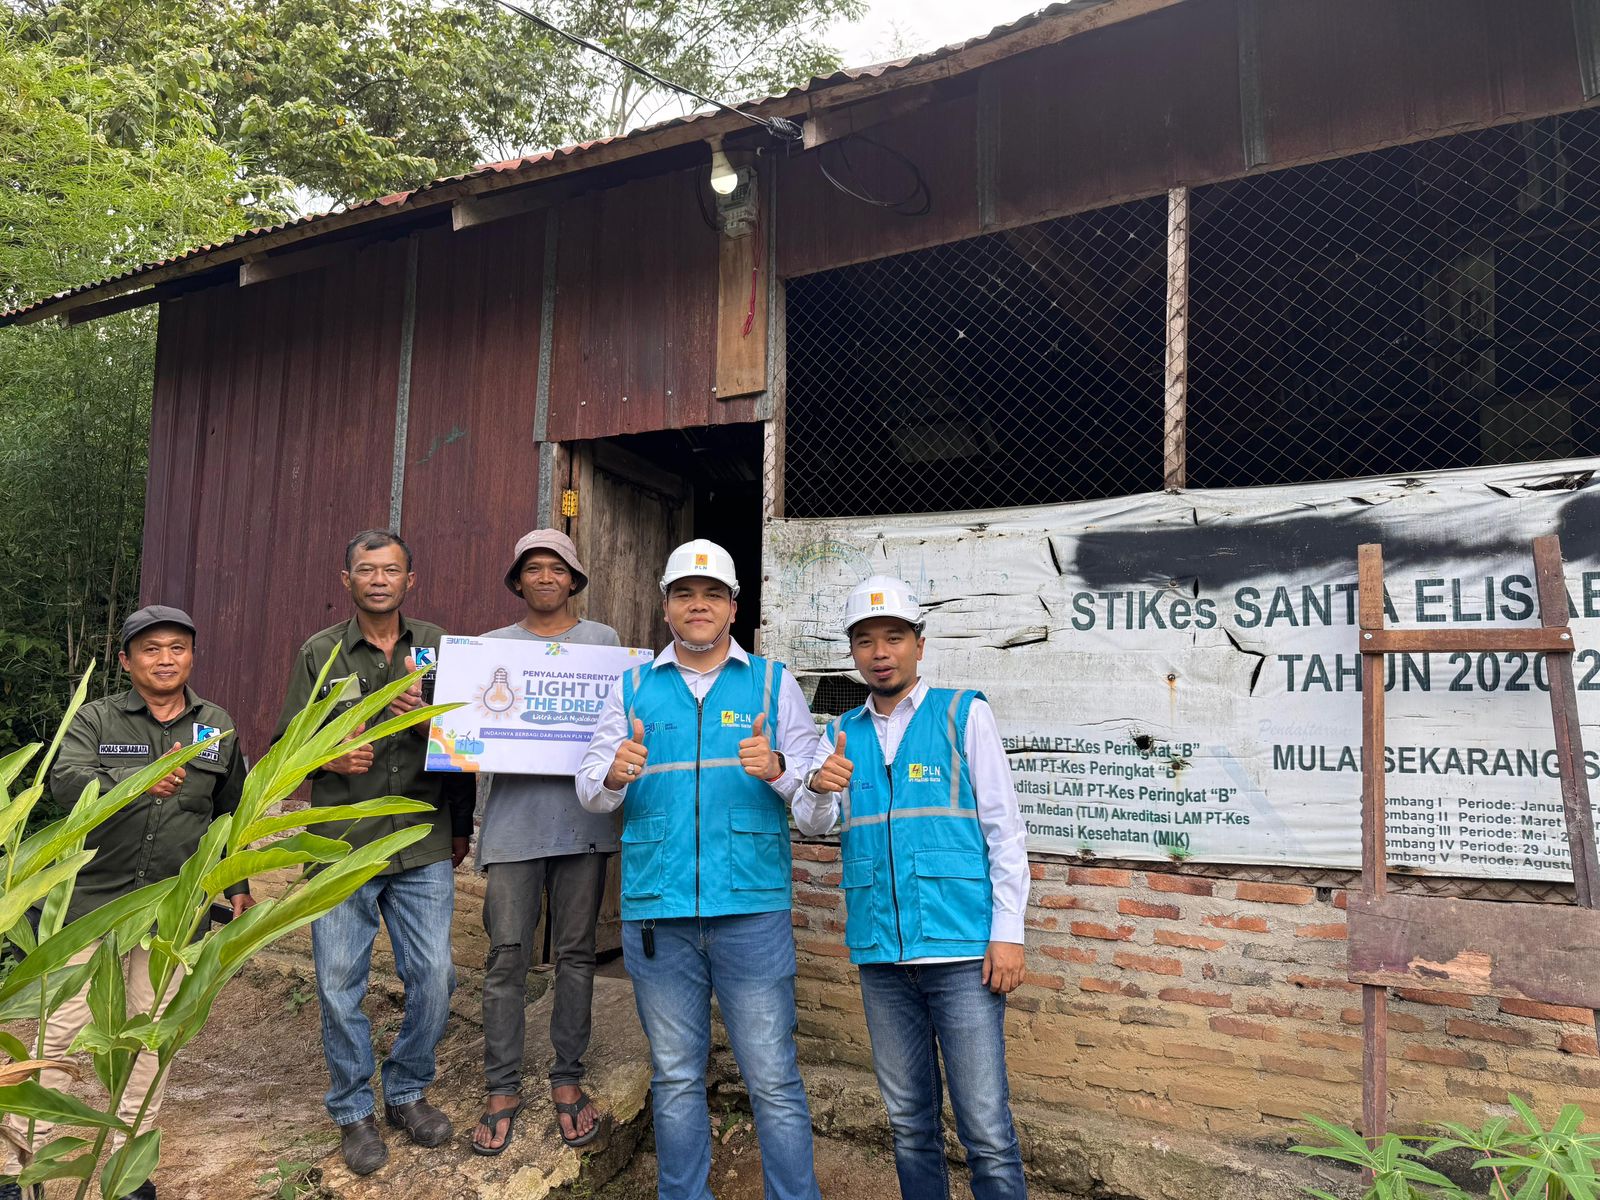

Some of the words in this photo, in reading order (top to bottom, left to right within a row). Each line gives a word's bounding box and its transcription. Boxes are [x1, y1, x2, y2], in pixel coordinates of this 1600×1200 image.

[1071, 590, 1217, 631] STIKes
[523, 670, 575, 680] PENYALAAN
[525, 680, 590, 699] LIGHT
[595, 683, 614, 699] U
[524, 697, 557, 711] THE
[561, 699, 604, 713] DREA
[734, 713, 751, 723] PLN
[1023, 736, 1051, 750] LAM
[1054, 738, 1100, 754] PT-Kes
[922, 765, 940, 775] PLN
[1009, 758, 1037, 772] LAM
[1040, 759, 1085, 774] PT-Kes
[1090, 761, 1155, 780] Peringkat
[1384, 747, 1561, 778] SEKARANG
[1054, 782, 1083, 796] LAM
[1087, 783, 1135, 800] PT-Kes
[1139, 786, 1207, 806] Peringkat
[1037, 803, 1073, 817] Medan
[1076, 806, 1108, 821] (TLM)
[1111, 808, 1171, 823] Akreditasi
[1175, 812, 1202, 825] LAM
[1206, 812, 1250, 825] PT-Kes
[1458, 798, 1516, 810] Periode:
[1520, 801, 1563, 813] Janua
[1459, 812, 1517, 825] Periode:
[1521, 815, 1562, 827] Maret
[1026, 821, 1074, 838] formasi
[1077, 825, 1149, 843] Kesehatan
[1153, 830, 1190, 850] (MIK)
[1459, 826, 1517, 839] Periode:
[1521, 829, 1547, 840] Mei
[1440, 840, 1454, 849] IV
[1460, 841, 1518, 853] Periode:
[1523, 844, 1539, 855] 29
[1543, 845, 1570, 857] Jun
[1440, 853, 1450, 862] V
[1461, 853, 1519, 866] Periode:
[1523, 858, 1573, 871] Agustu
